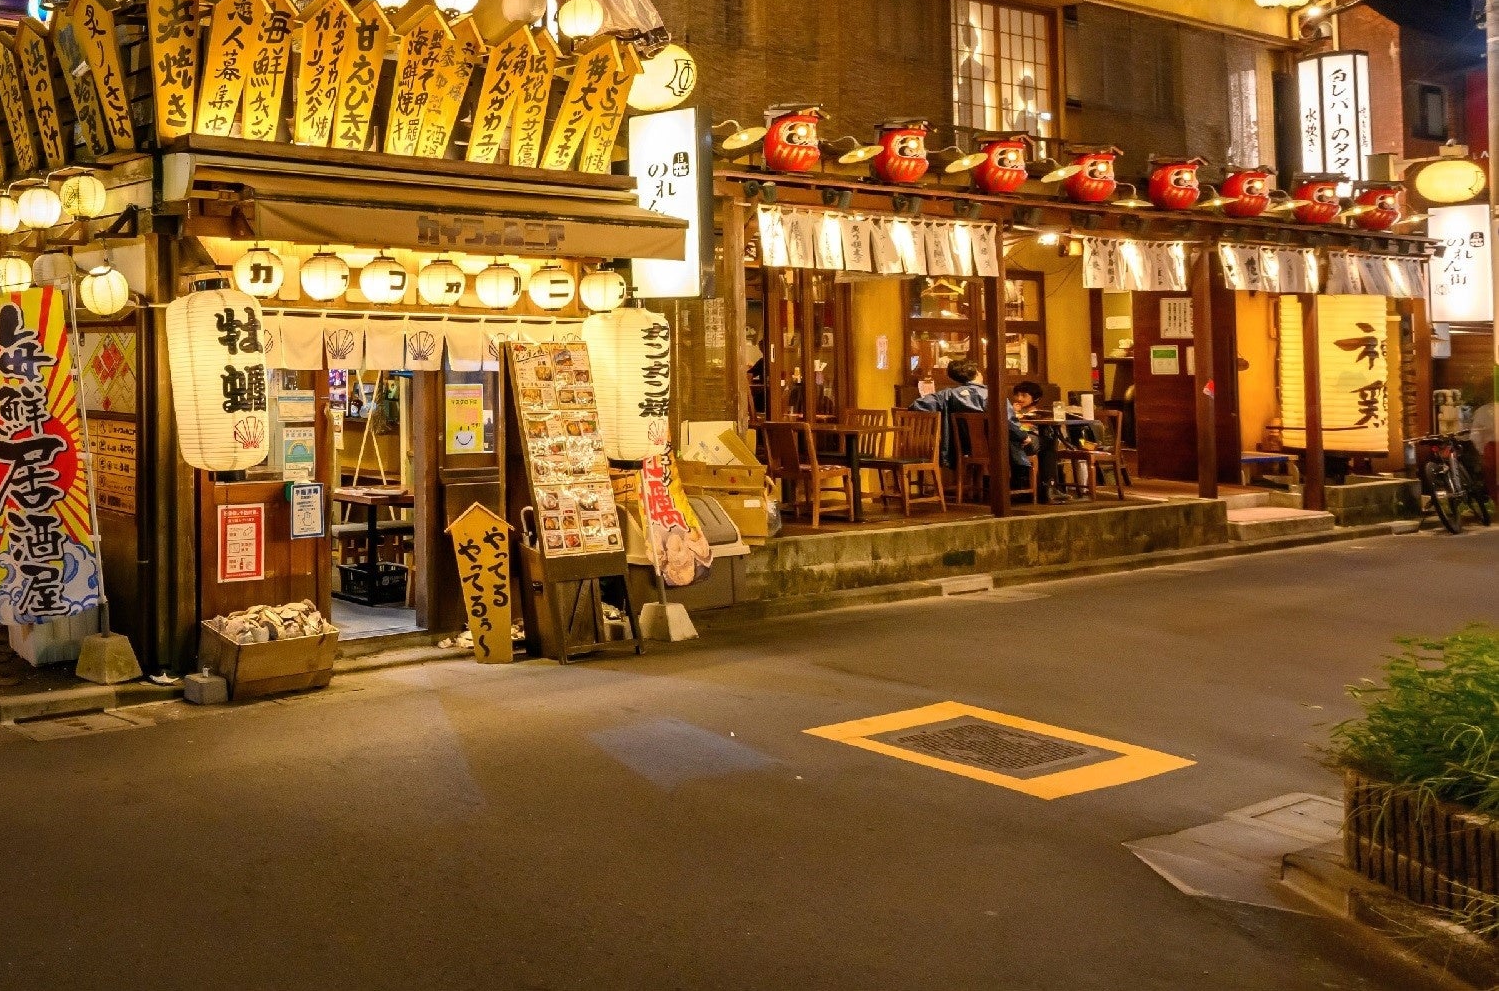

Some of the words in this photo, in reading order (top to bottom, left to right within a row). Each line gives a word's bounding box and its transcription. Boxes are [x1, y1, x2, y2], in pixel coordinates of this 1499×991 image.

[339, 18, 380, 149] 甘えびキム
[1329, 68, 1351, 174] 白レバーのタタ
[213, 306, 267, 414] 牡蠣
[483, 526, 509, 608] やってる
